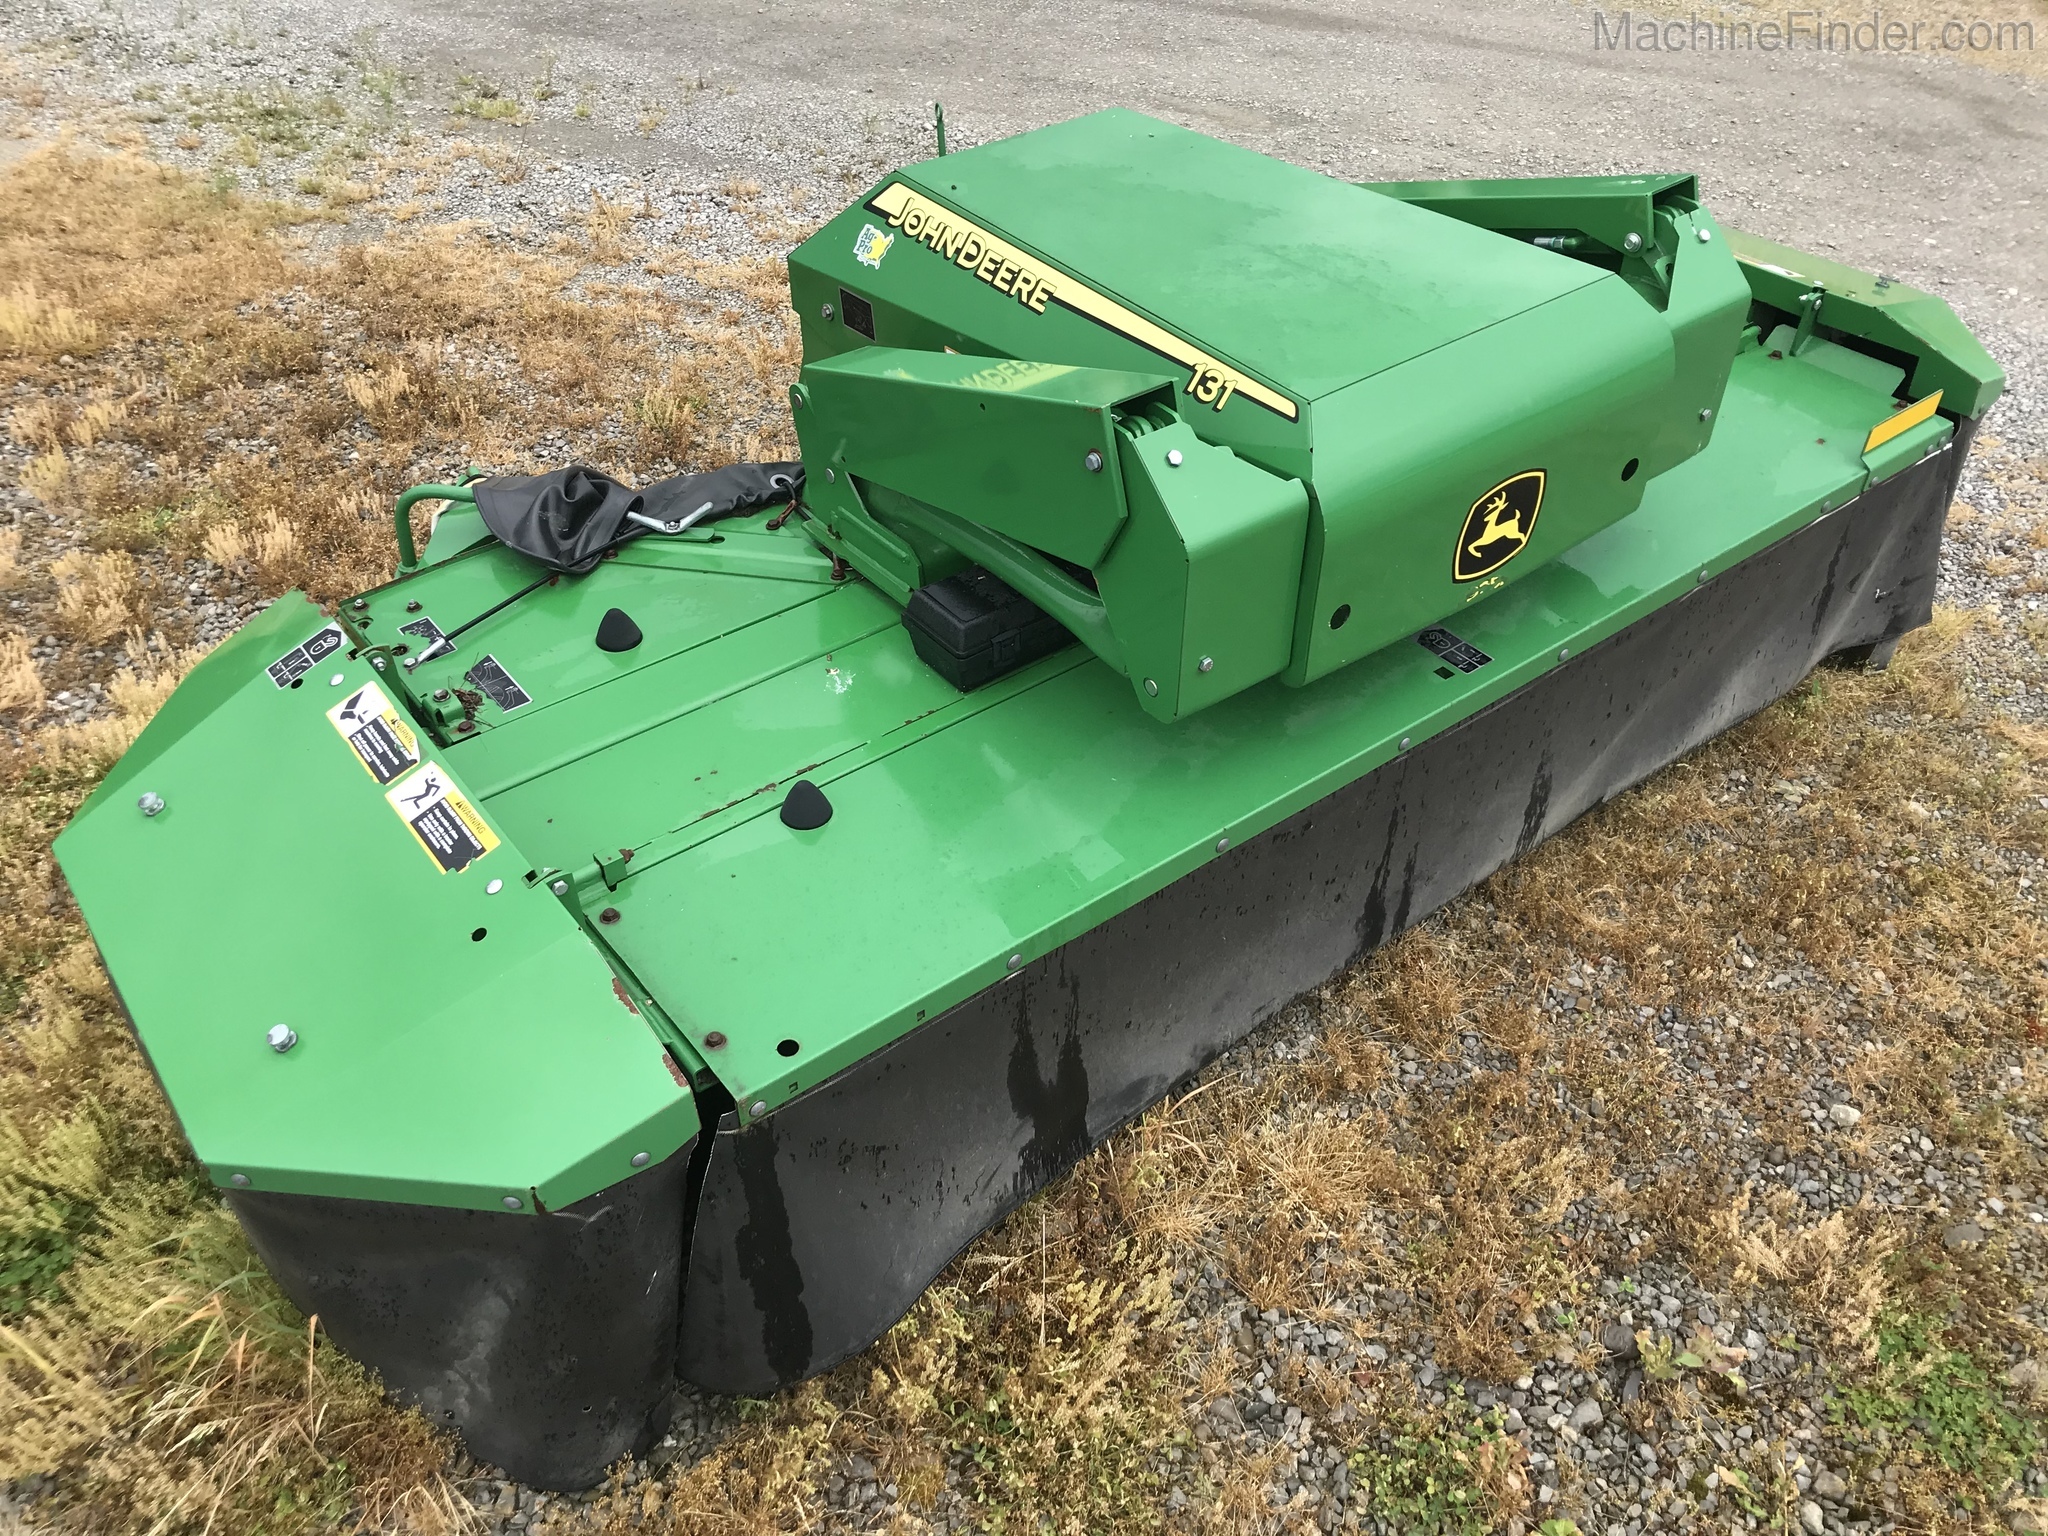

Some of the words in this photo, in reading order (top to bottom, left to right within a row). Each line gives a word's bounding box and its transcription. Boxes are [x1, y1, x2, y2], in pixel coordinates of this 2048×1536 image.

[856, 240, 873, 254] Pro
[1182, 362, 1238, 413] 131
[460, 805, 487, 835] WARNING
